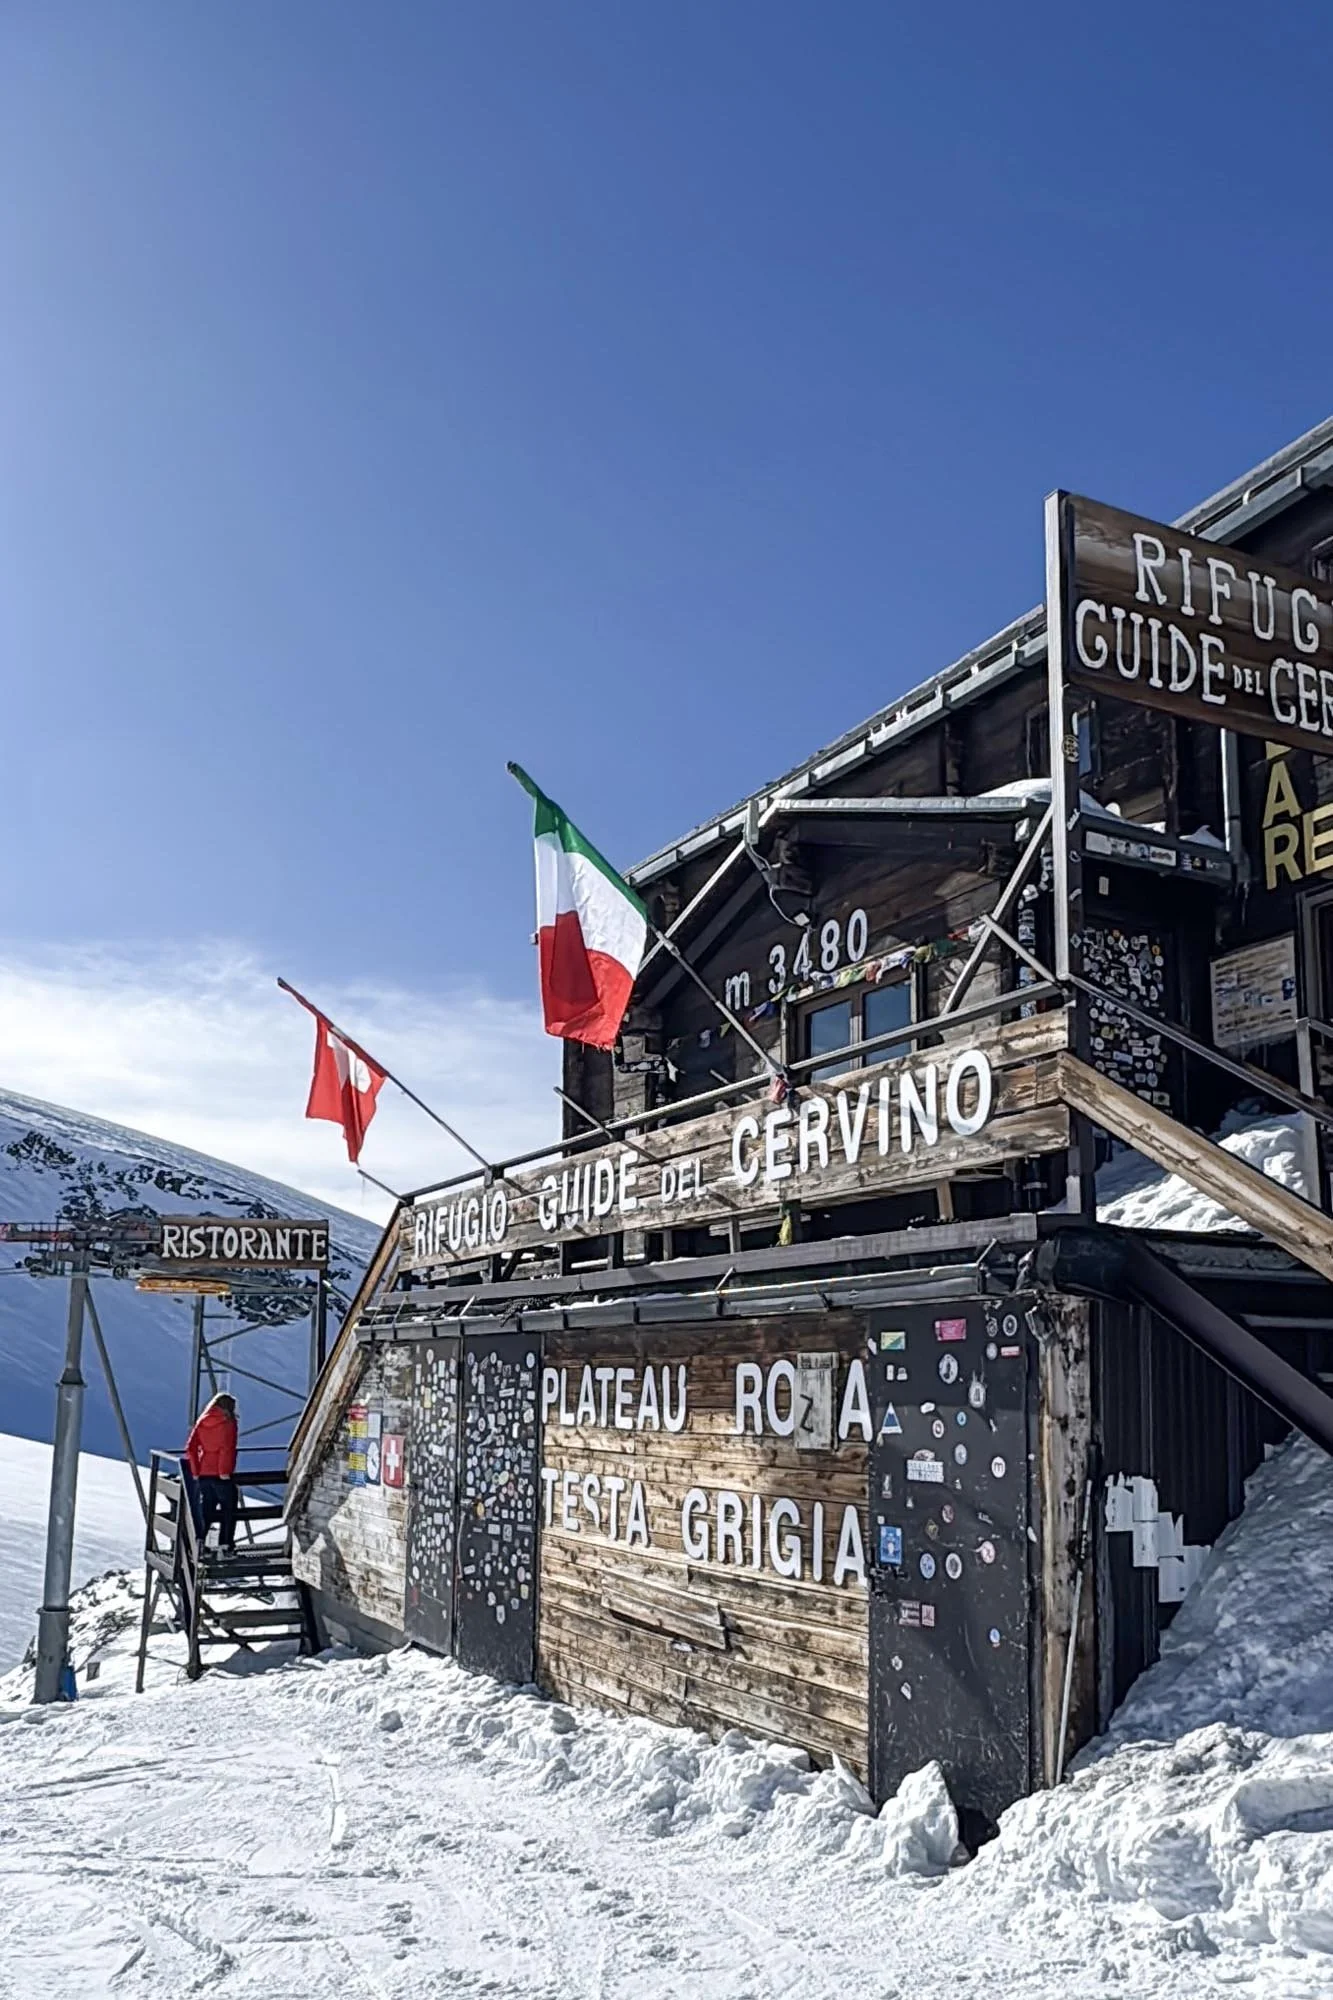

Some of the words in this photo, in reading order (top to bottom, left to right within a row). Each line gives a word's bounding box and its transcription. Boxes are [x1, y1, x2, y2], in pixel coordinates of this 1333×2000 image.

[1133, 533, 1333, 654] RIFUG
[1075, 599, 1227, 705] GUIDE
[1232, 664, 1265, 697] DEL
[725, 971, 751, 1011] m
[768, 908, 869, 996] 3480
[414, 1190, 508, 1258] RIFUGIO
[538, 1150, 640, 1234] GUIDE
[660, 1157, 705, 1203] DEL
[732, 1049, 992, 1187] CERVINO
[161, 1224, 329, 1263] RISTORANTE
[542, 1364, 687, 1433] PLATEAU
[540, 1466, 650, 1548] TESTA
[681, 1487, 868, 1587] GRIGIA
